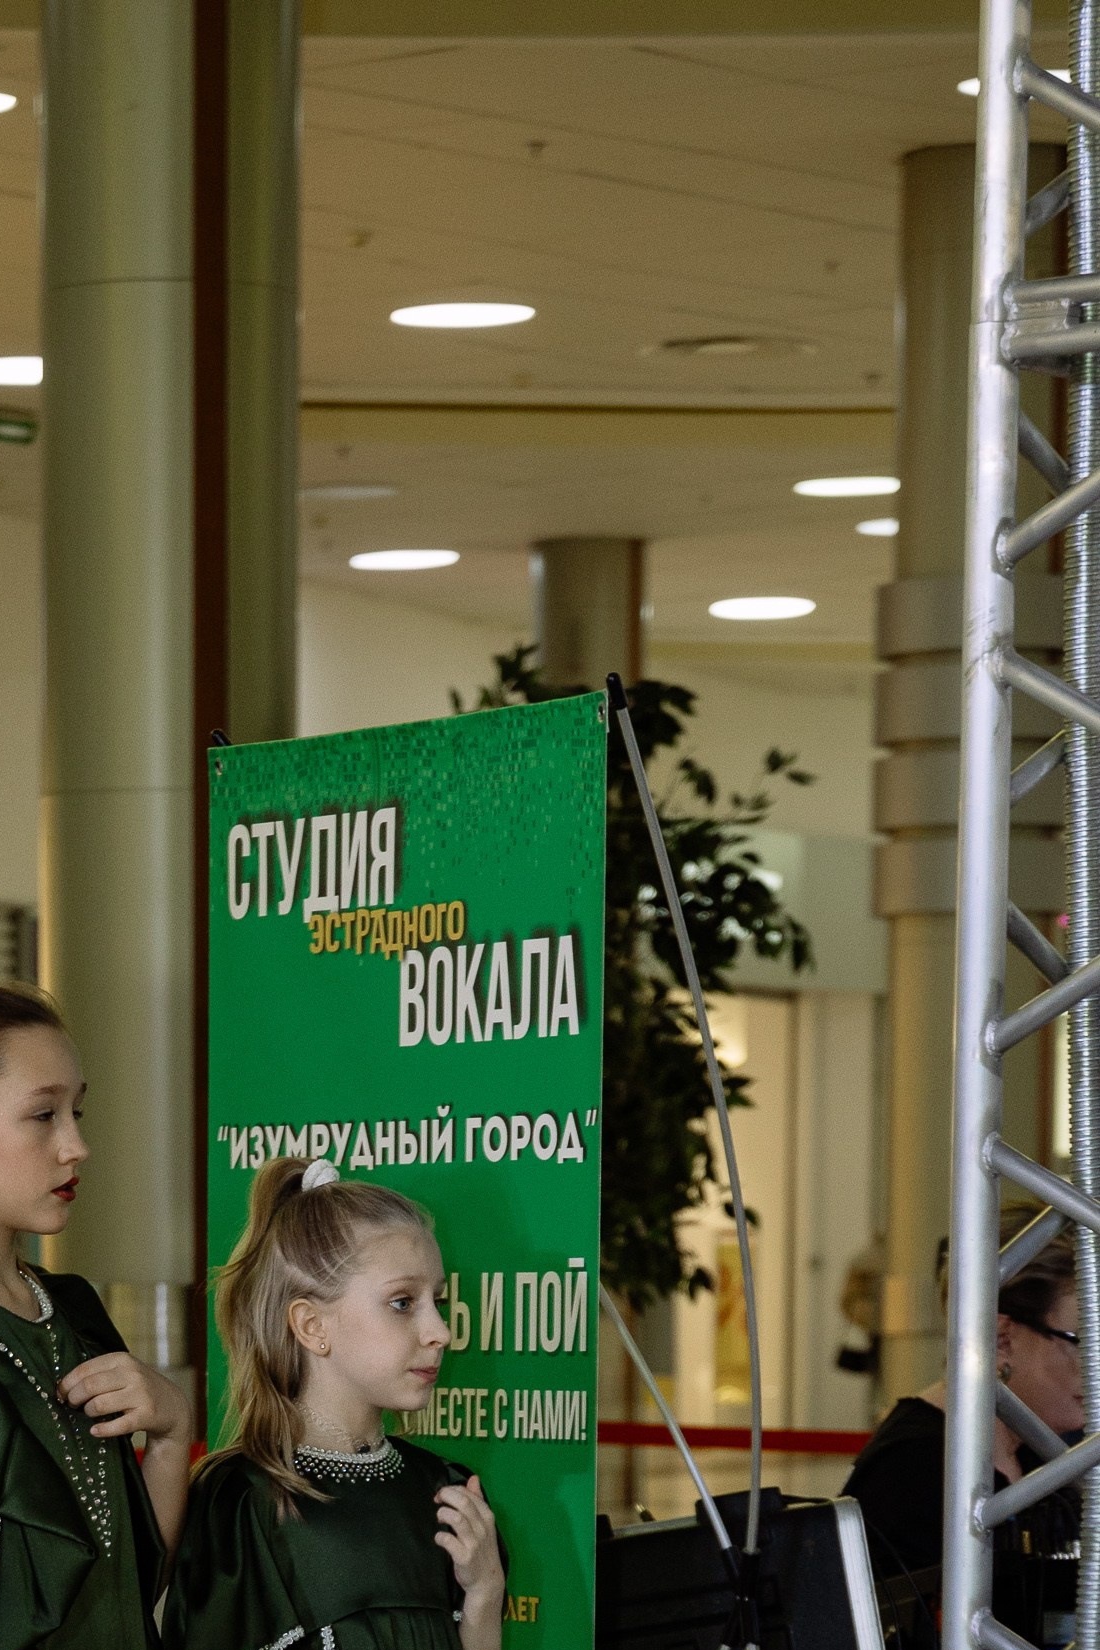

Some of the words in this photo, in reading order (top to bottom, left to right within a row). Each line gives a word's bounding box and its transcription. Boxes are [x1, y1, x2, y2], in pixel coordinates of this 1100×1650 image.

[227, 806, 397, 923] СТУДИЯ
[309, 900, 466, 961] ЭСТРАДНОГО
[399, 934, 580, 1047] ВОКАЛА
[464, 1108, 598, 1165] ГОРОД"
[480, 1272, 504, 1352] И
[514, 1257, 588, 1353] ПОЙ
[493, 1388, 508, 1439] С
[513, 1389, 588, 1441] НАМИ!
[503, 1595, 540, 1622] ЛЕТ
